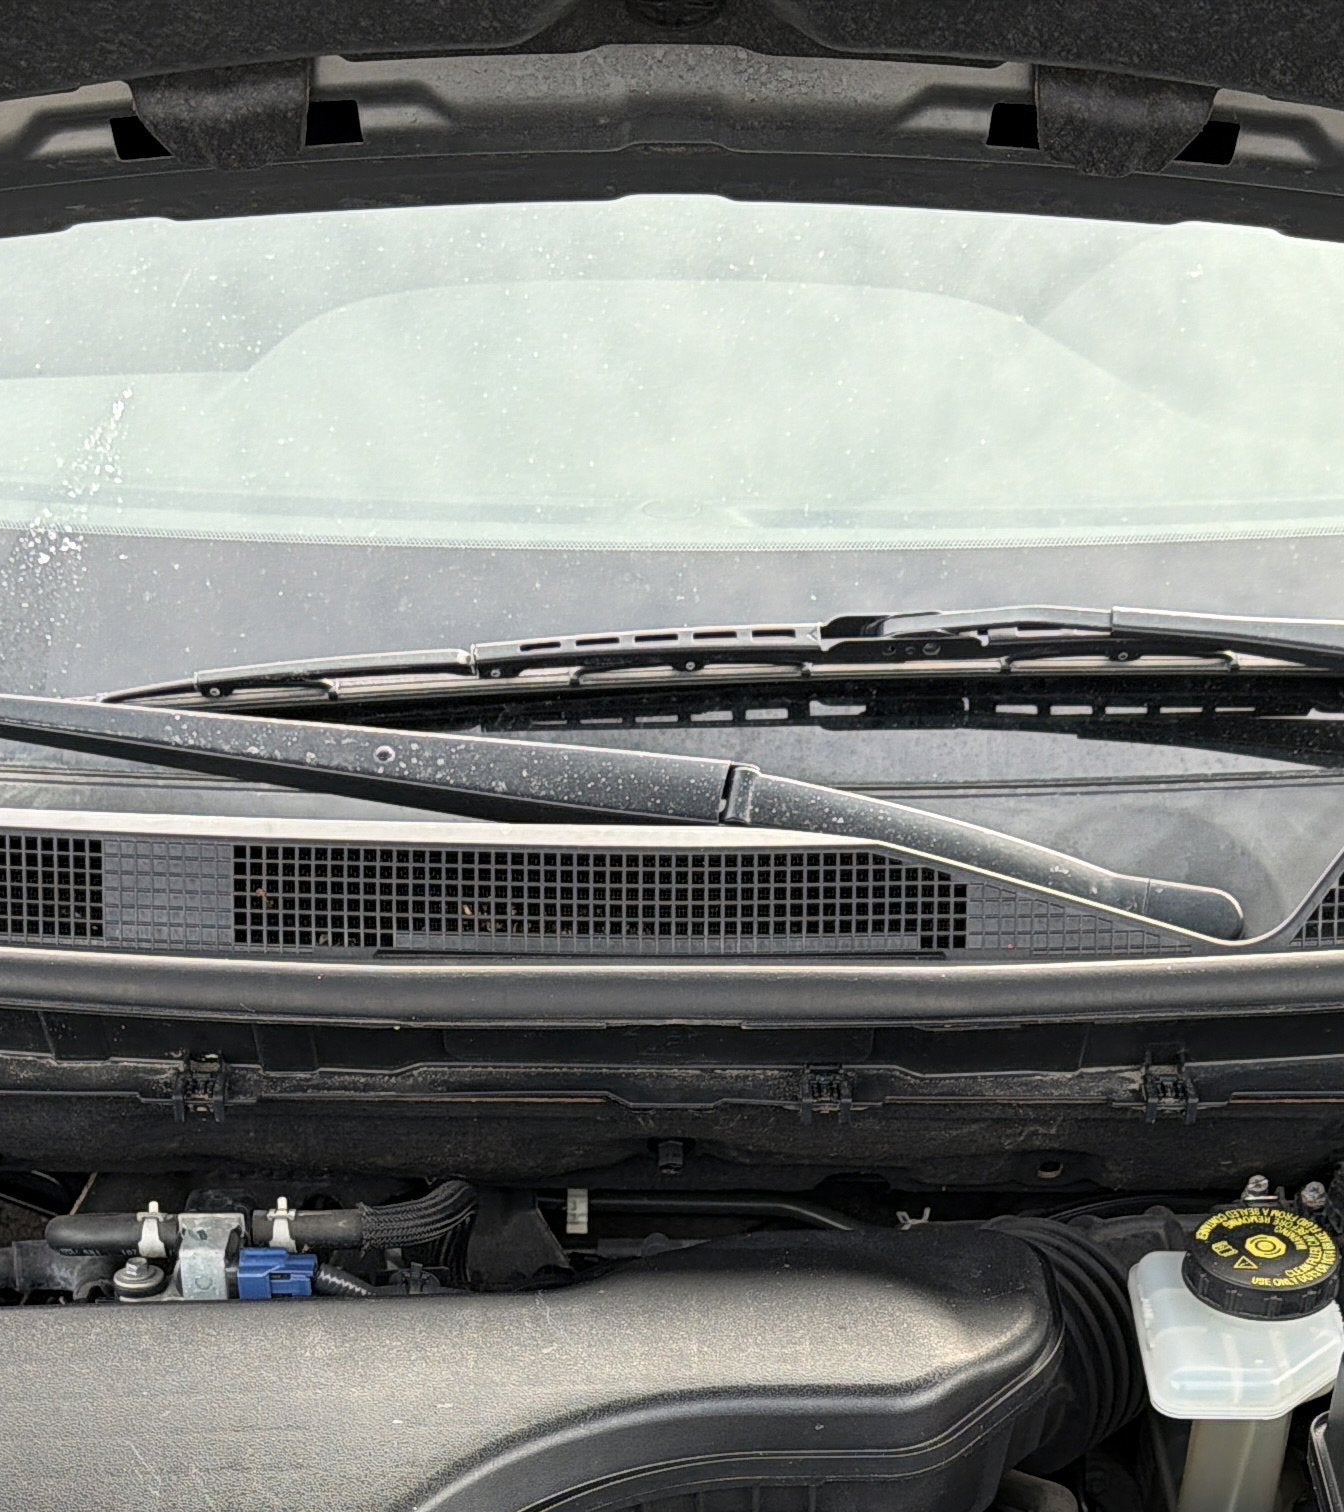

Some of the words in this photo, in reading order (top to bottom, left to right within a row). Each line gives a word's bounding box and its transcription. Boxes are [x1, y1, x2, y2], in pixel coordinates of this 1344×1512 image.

[1225, 1207, 1260, 1219] SEALED
[1270, 1209, 1297, 1221] FROM
[1251, 1276, 1271, 1286] USE
[1273, 1277, 1298, 1287] ONLY
